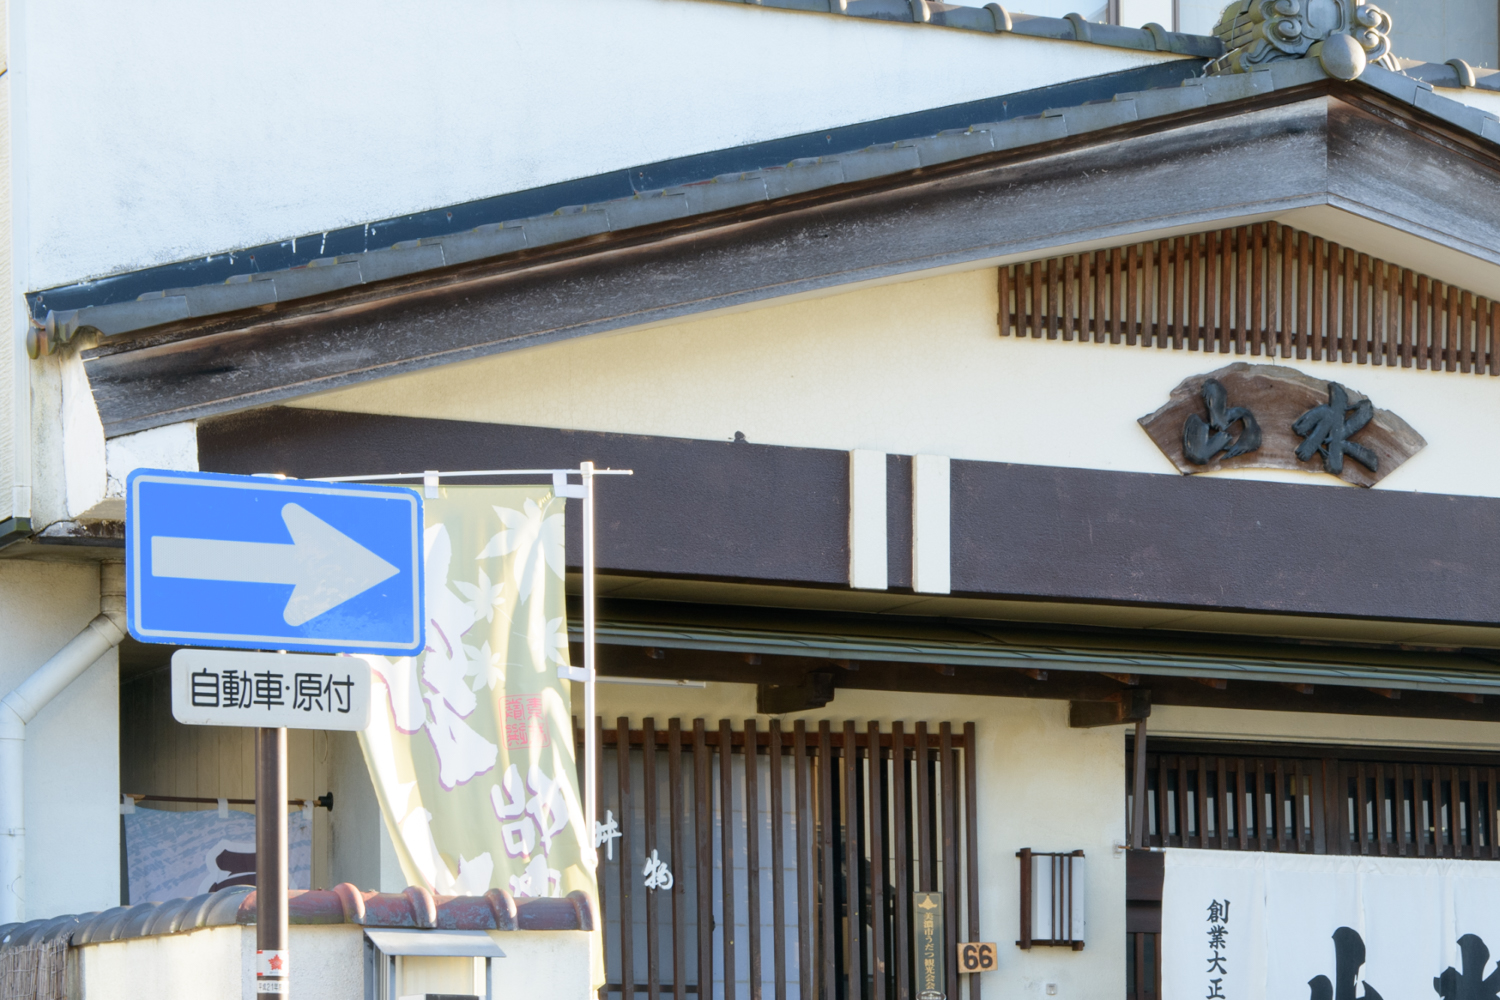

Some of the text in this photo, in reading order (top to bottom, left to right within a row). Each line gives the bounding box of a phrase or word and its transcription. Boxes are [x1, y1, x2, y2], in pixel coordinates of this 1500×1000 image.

[1181, 378, 1379, 474] 山水
[193, 669, 355, 714] 自動車・原付
[963, 944, 993, 970] 66
